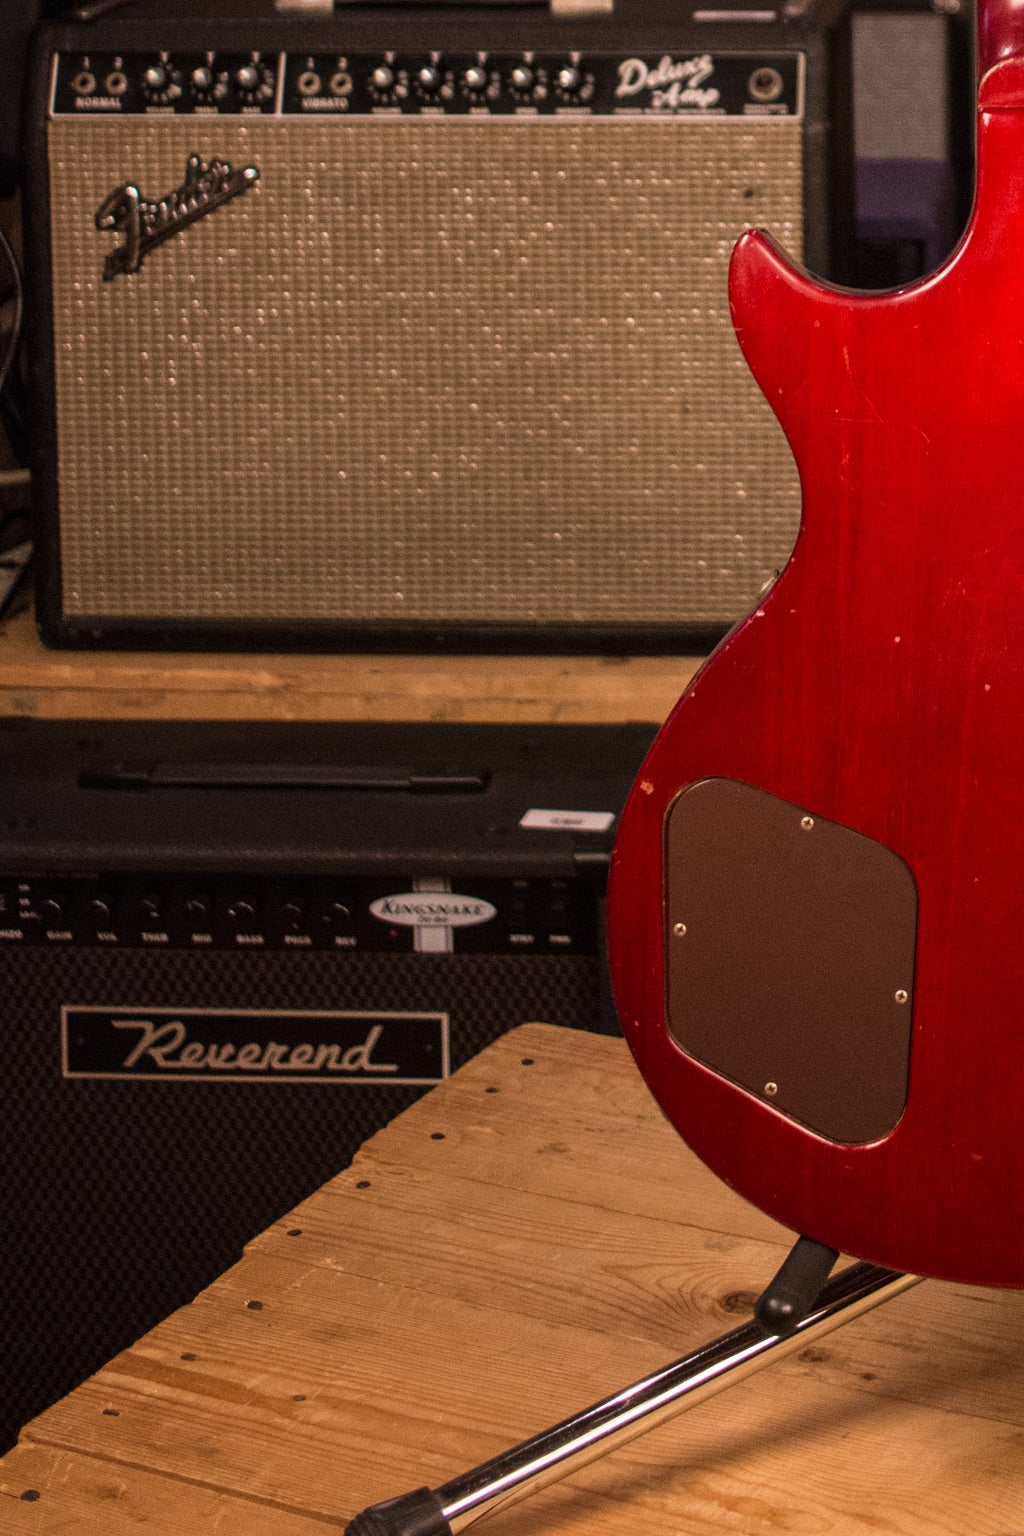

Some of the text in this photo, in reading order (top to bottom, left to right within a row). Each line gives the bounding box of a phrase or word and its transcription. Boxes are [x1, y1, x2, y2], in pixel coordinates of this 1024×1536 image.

[614, 54, 714, 99] Deluxe
[75, 96, 122, 109] NORMAL
[301, 96, 349, 111] VIBRATO
[651, 82, 720, 108] Amp
[111, 1019, 398, 1072] Reverend
